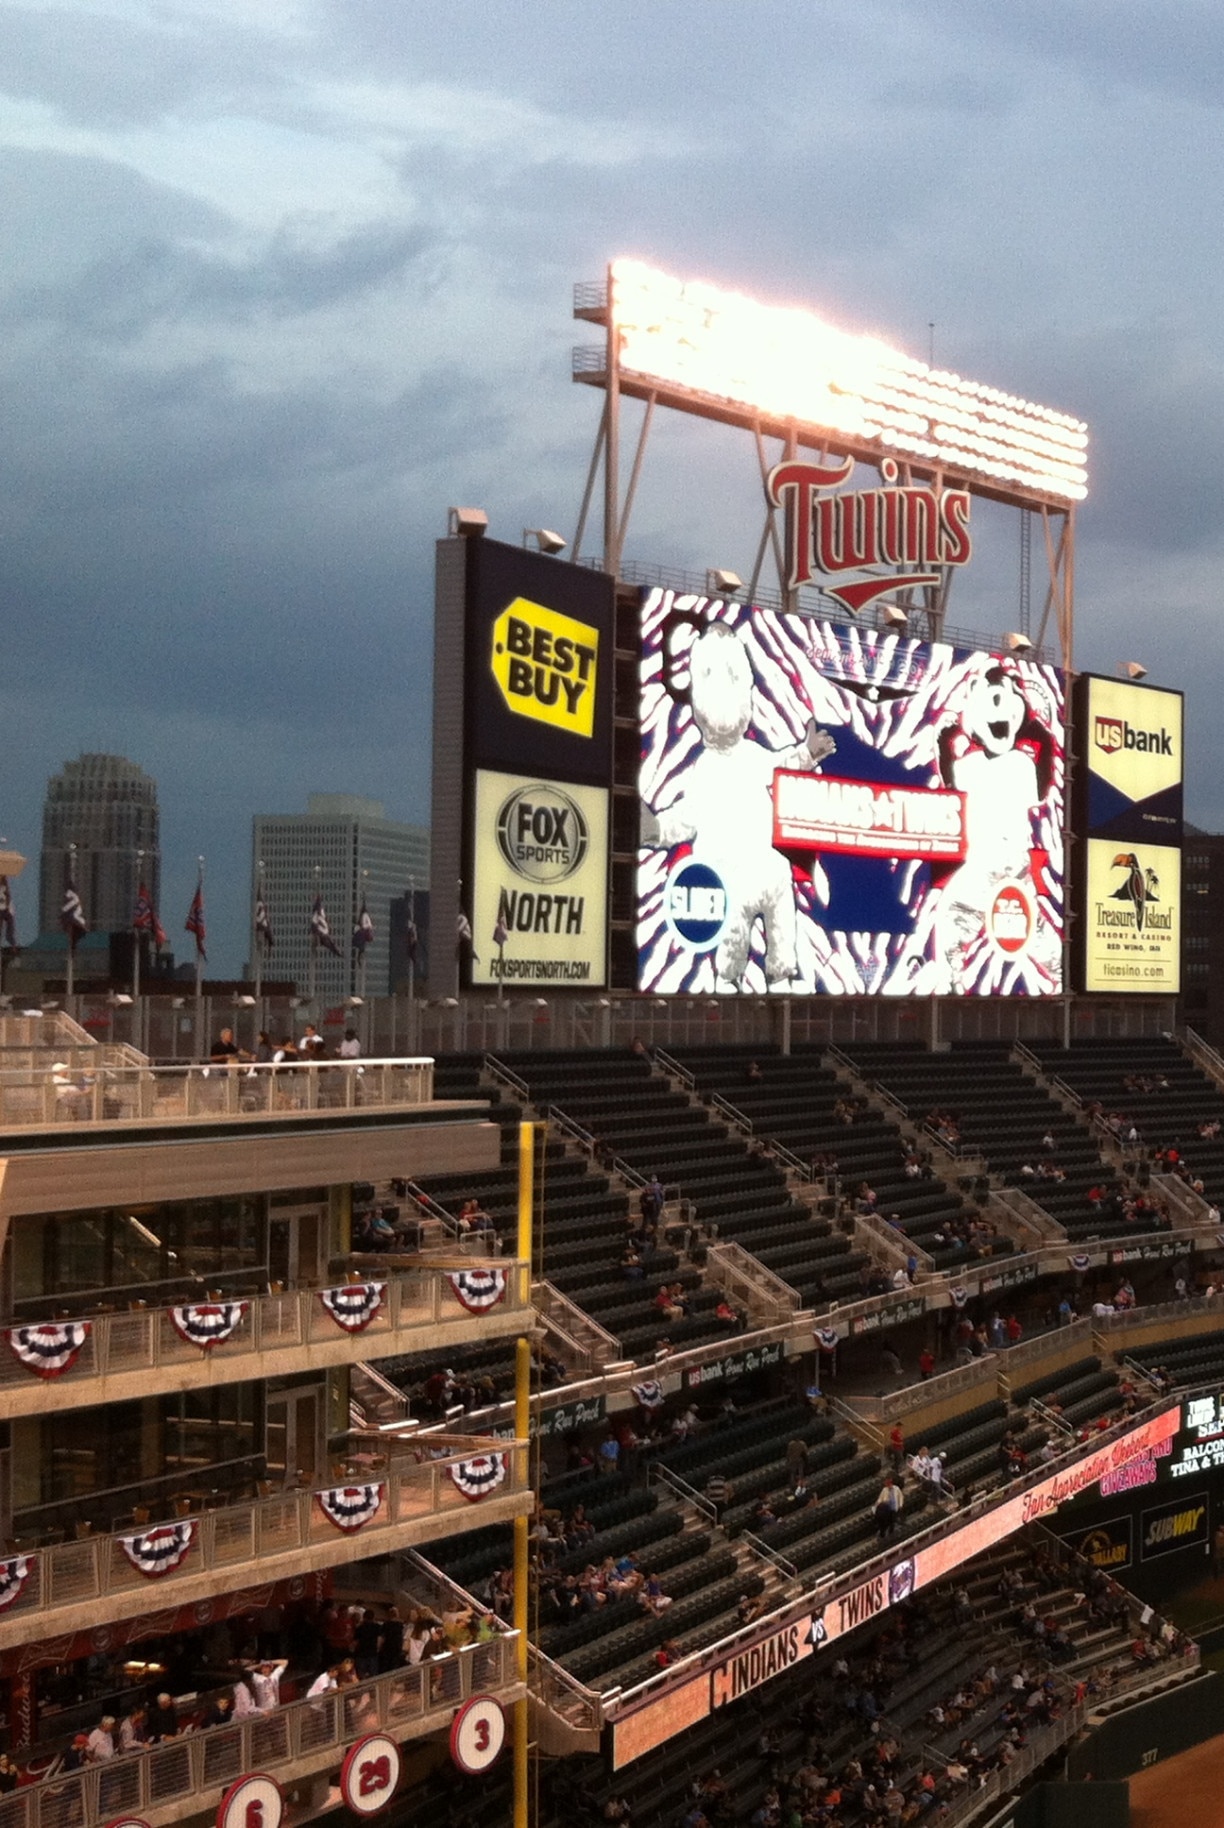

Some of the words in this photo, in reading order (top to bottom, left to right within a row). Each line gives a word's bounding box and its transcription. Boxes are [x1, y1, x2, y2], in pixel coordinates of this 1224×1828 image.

[768, 455, 972, 590] Twins
[506, 616, 596, 680] BEST
[507, 662, 586, 714] BUY
[517, 803, 570, 848] FOX
[516, 846, 571, 865] SPORTS
[501, 889, 585, 935] NORTH
[1095, 903, 1136, 927] Treasure
[1145, 905, 1172, 929] Island
[490, 959, 591, 980] FOXSPORTSNORTH.COM
[1103, 964, 1164, 977] ticasino.com
[1100, 1459, 1157, 1497] GIVEAWAYS
[1171, 1461, 1200, 1477] TINA
[1202, 1457, 1211, 1468] &
[1022, 1493, 1044, 1523] Fan
[1045, 1458, 1109, 1506] Appreciation
[1145, 1506, 1204, 1545] SUBWAY
[732, 1626, 798, 1698] INDIANS
[811, 1619, 824, 1642] VS
[838, 1577, 884, 1632] TWINS
[474, 1718, 490, 1751] 3
[359, 1755, 391, 1796] 29
[1142, 1748, 1158, 1766] 377
[245, 1799, 263, 1828] 6
